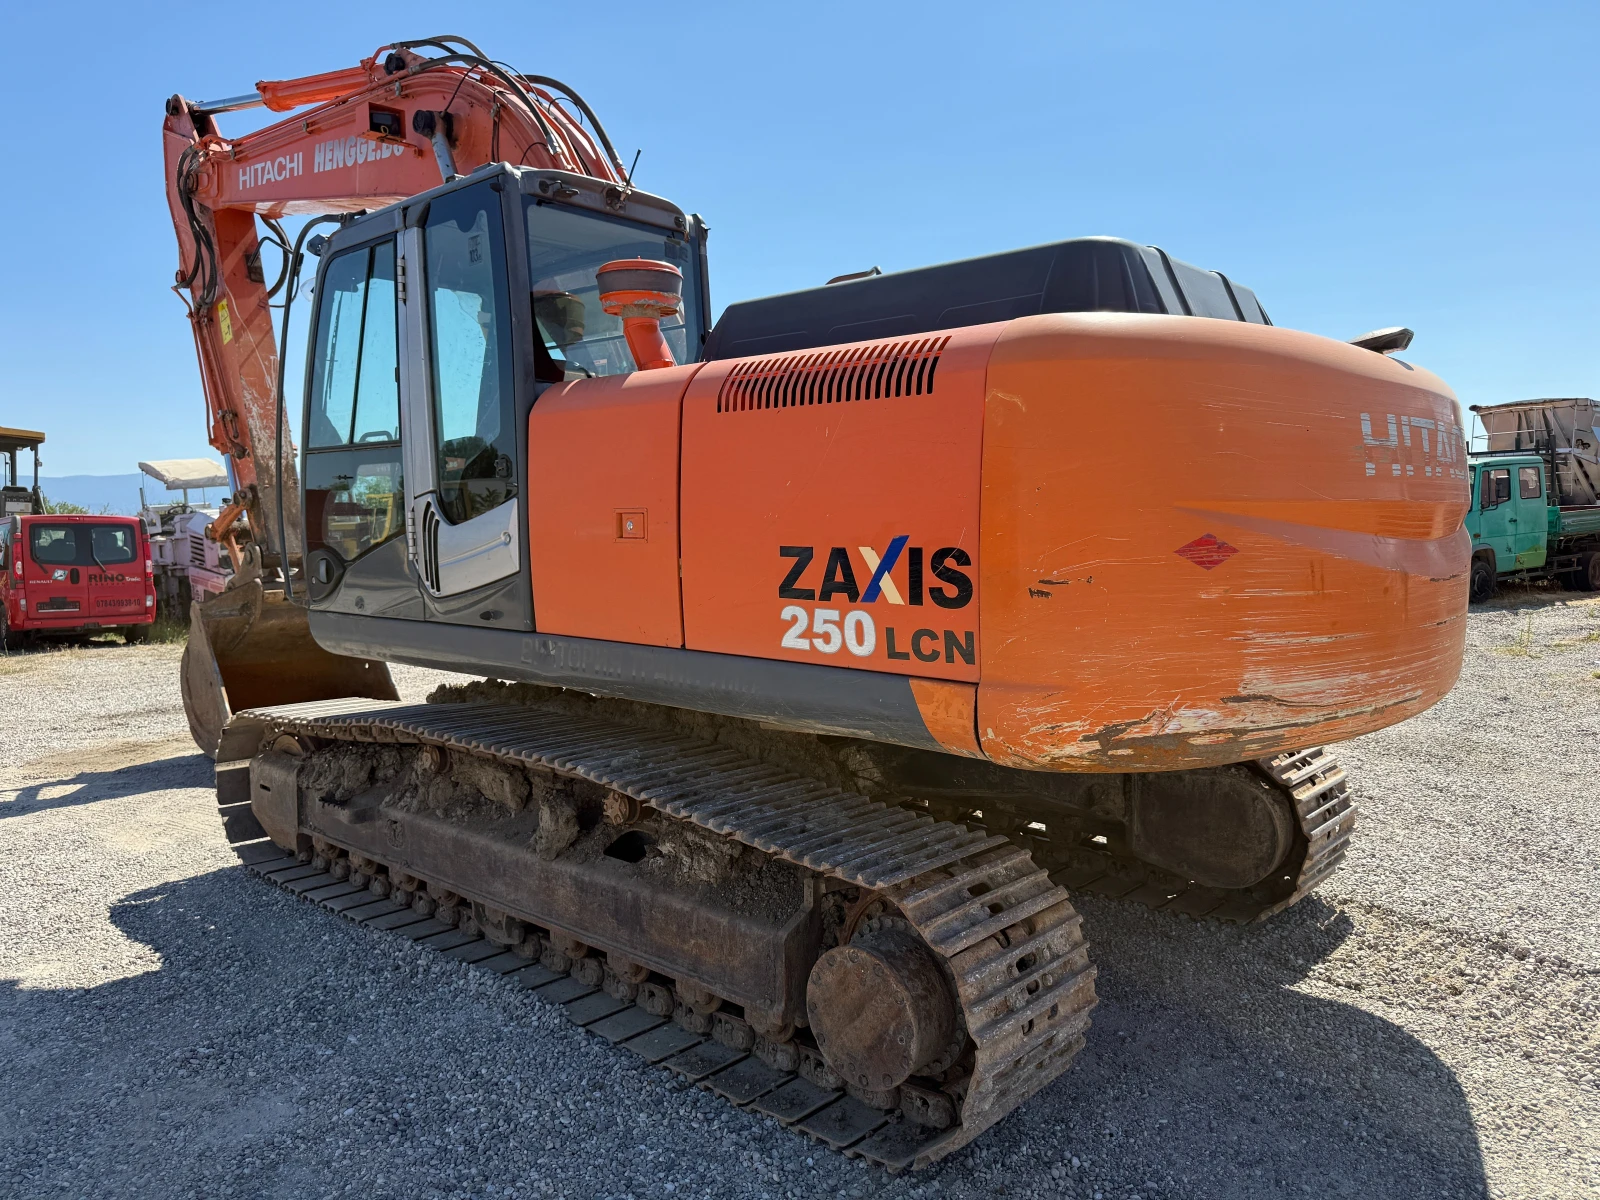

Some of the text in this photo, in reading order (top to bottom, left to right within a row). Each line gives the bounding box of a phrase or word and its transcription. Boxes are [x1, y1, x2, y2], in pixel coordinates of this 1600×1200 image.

[239, 152, 303, 190] HITACHI
[88, 573, 125, 583] RINO
[779, 535, 973, 609] ZAXIS
[780, 605, 975, 665] 250 LCN
